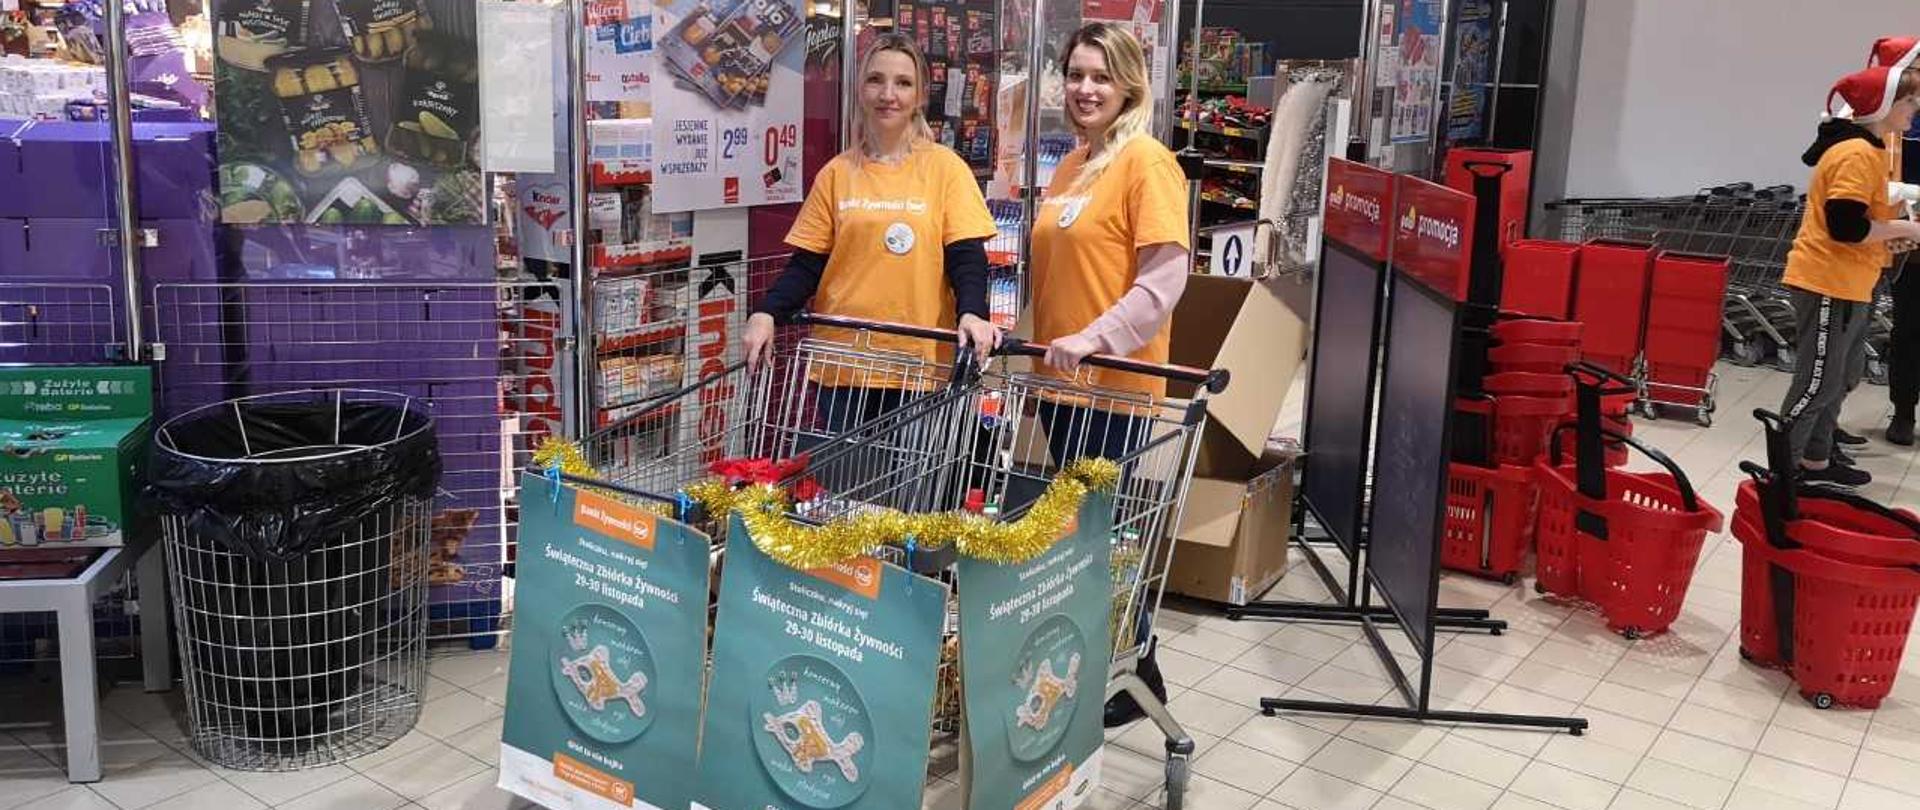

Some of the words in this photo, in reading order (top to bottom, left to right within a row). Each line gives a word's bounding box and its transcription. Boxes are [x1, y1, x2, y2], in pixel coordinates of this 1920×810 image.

[675, 133, 708, 145] WYDANIE
[1344, 192, 1380, 222] promocja
[1417, 215, 1459, 249] promocja
[543, 543, 595, 573] Świąteczna
[596, 563, 634, 587] Zbiórka
[635, 575, 680, 604] Żywności
[575, 573, 601, 593] 29-30
[601, 582, 644, 609] listopada
[751, 586, 808, 622] Świąteczna
[810, 611, 851, 639] Zbiórka
[853, 625, 904, 661] Żywności
[784, 619, 815, 644] 29-30
[815, 631, 864, 663] listopada
